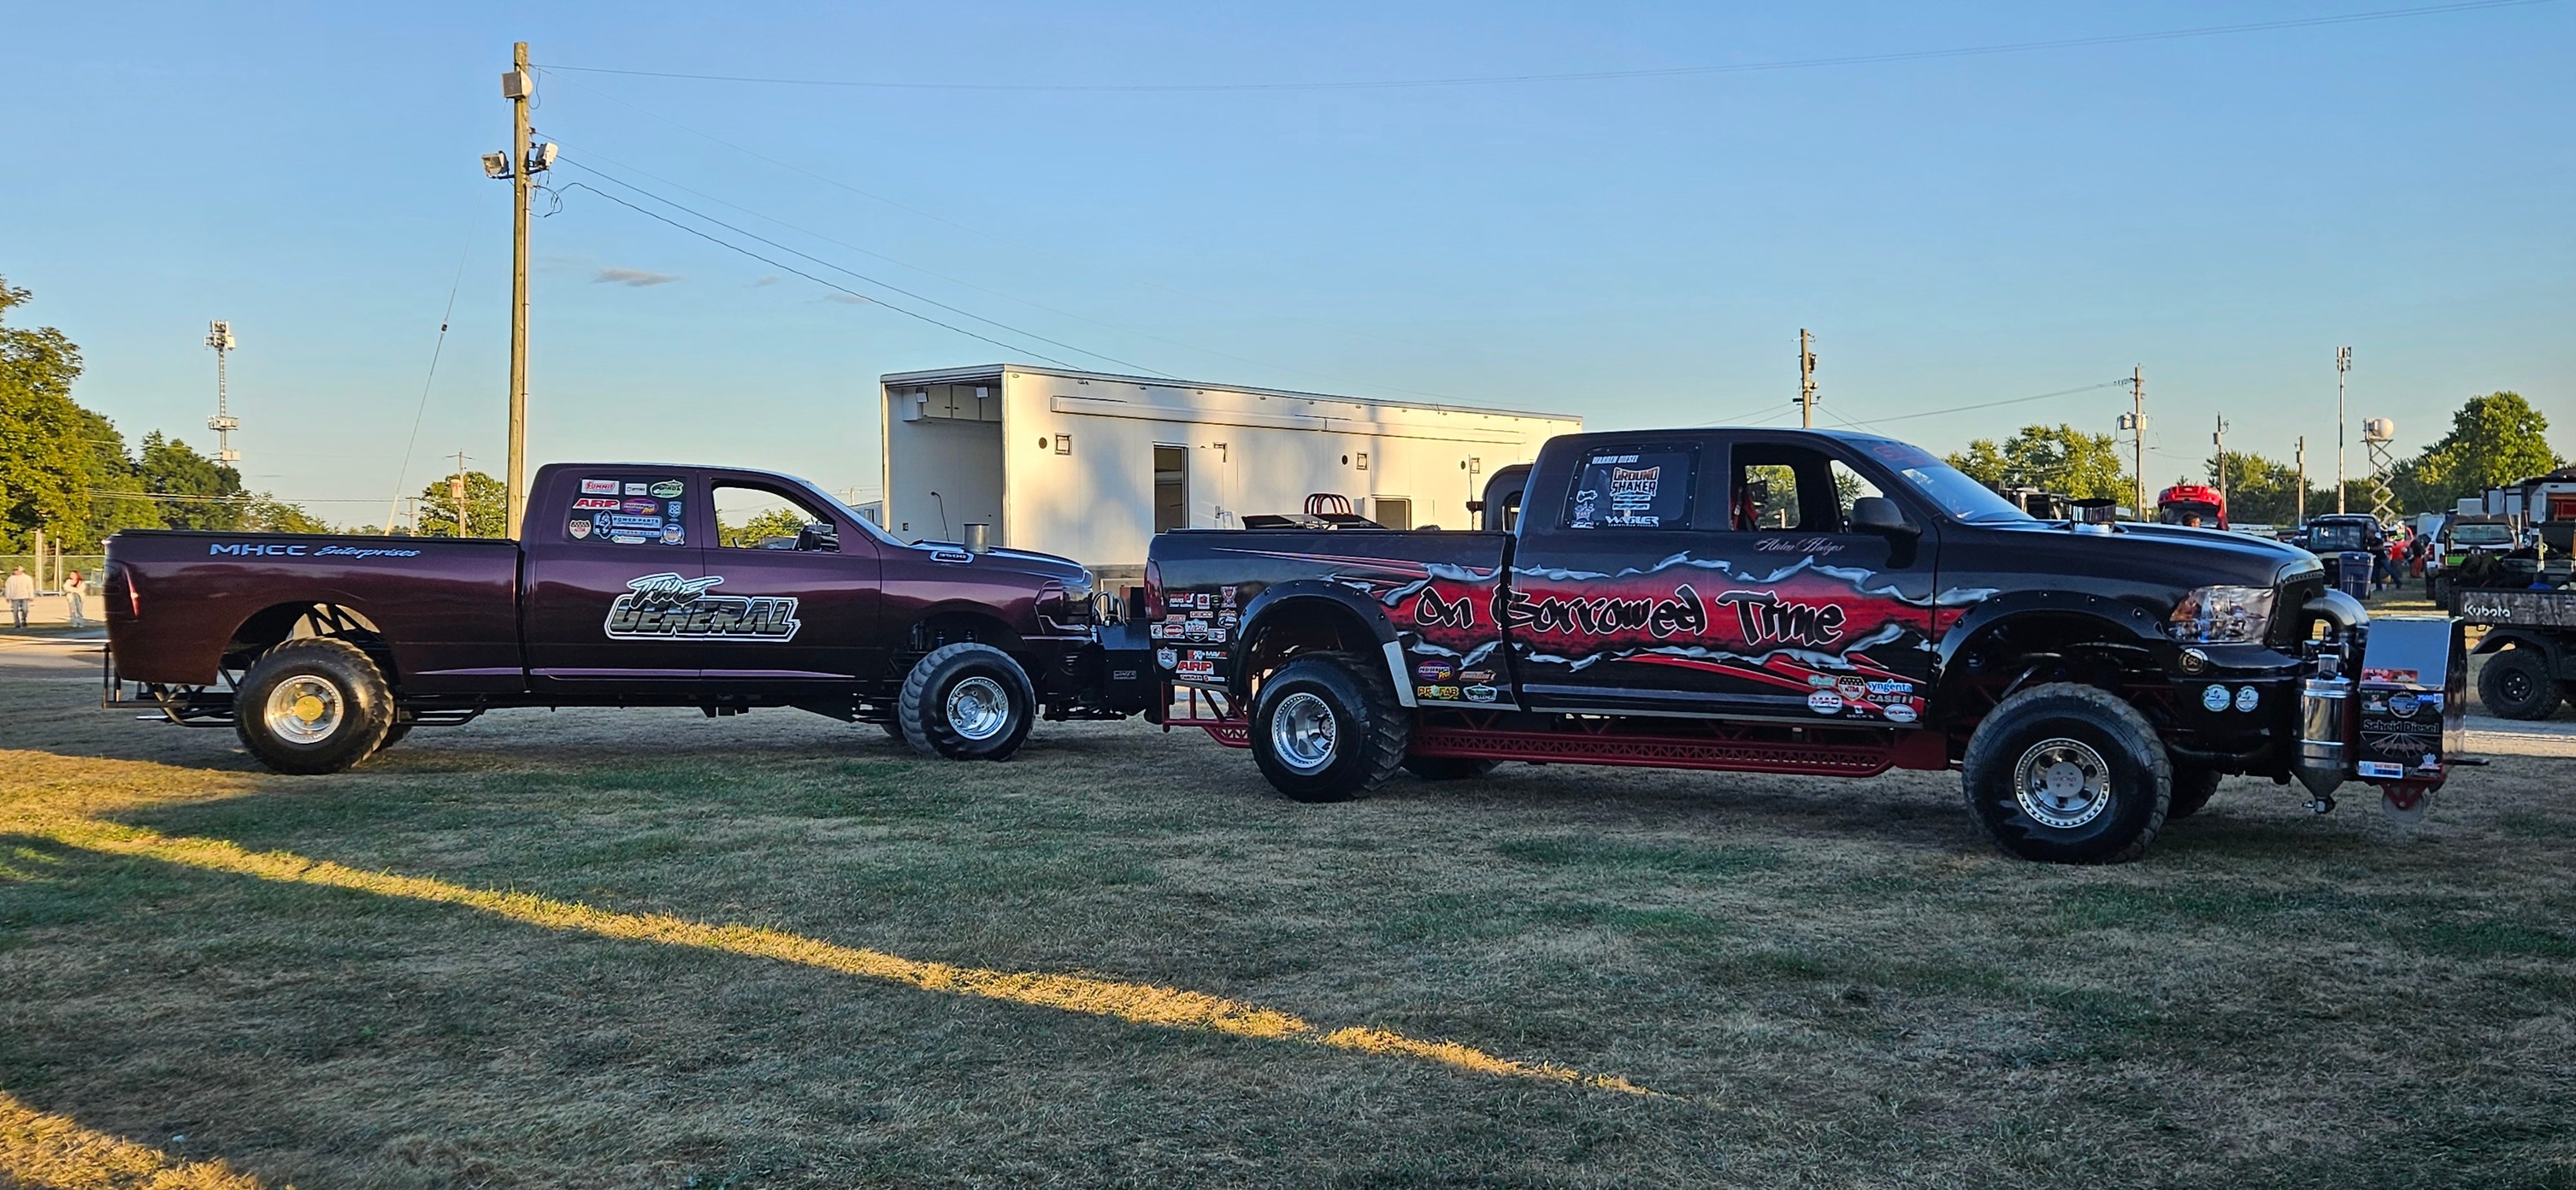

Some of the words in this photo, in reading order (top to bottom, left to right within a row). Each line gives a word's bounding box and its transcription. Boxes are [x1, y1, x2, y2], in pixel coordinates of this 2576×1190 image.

[1592, 456, 1618, 464] WARREN
[1618, 455, 1640, 463] DIESEL
[1613, 467, 1659, 480] GROUND
[1611, 480, 1657, 496] SHAKER
[576, 499, 619, 508] ARP
[209, 544, 308, 557] MHCC
[314, 545, 421, 559] Enterprises
[608, 598, 797, 635] GENERAL
[1415, 585, 1474, 629] On
[1489, 584, 1708, 639] Borrowed
[2464, 604, 2511, 617] Kubota
[1178, 662, 1211, 671] ARP
[1866, 680, 1913, 692] syngenta
[1866, 695, 1901, 704] CASE
[2363, 719, 2402, 732] Scheid
[2404, 722, 2439, 733] Diesel
